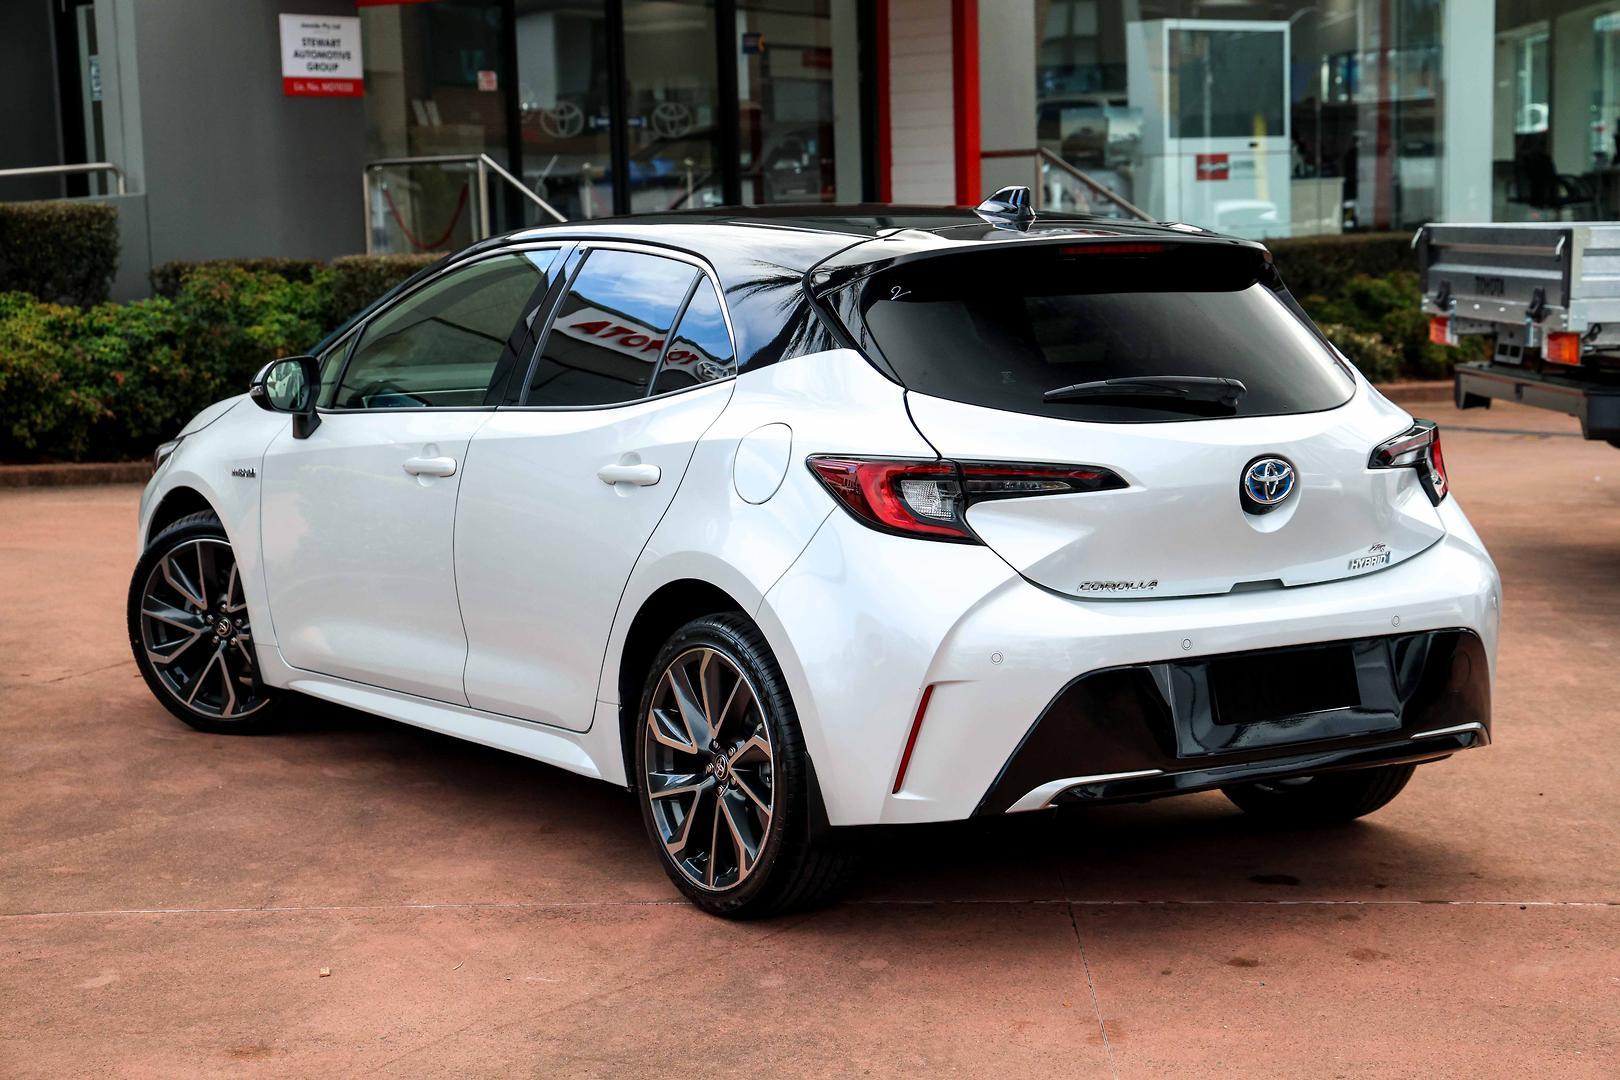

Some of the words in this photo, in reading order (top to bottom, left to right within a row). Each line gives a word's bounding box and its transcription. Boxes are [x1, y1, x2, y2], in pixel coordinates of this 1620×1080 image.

[302, 37, 341, 48] STEWART
[293, 50, 352, 61] AUTOMOTIVE
[306, 62, 339, 72] GROUP
[1350, 553, 1387, 570] HYBRID
[1077, 580, 1158, 592] COROLLA
